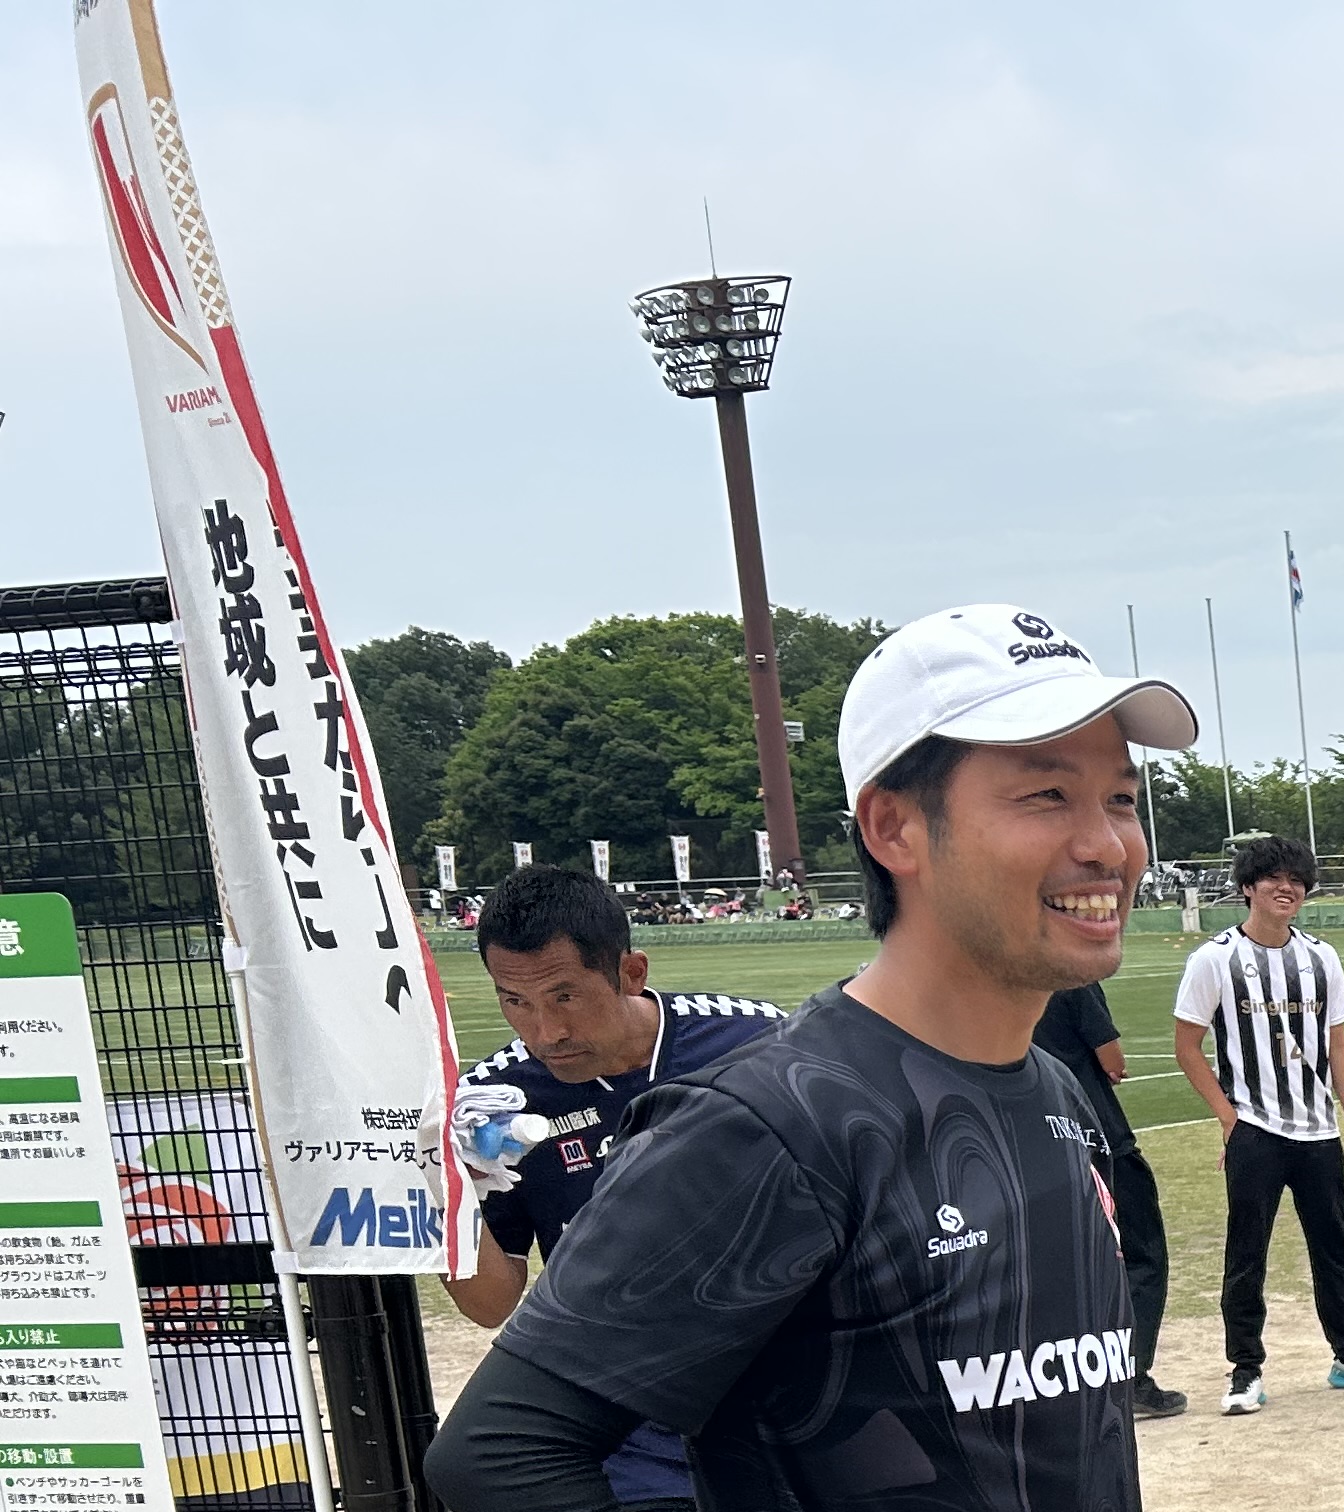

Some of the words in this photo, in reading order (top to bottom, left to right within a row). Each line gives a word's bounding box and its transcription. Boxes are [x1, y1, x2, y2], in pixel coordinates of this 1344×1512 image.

[203, 499, 338, 952] 地域と共に
[928, 1229, 989, 1259] Squadra
